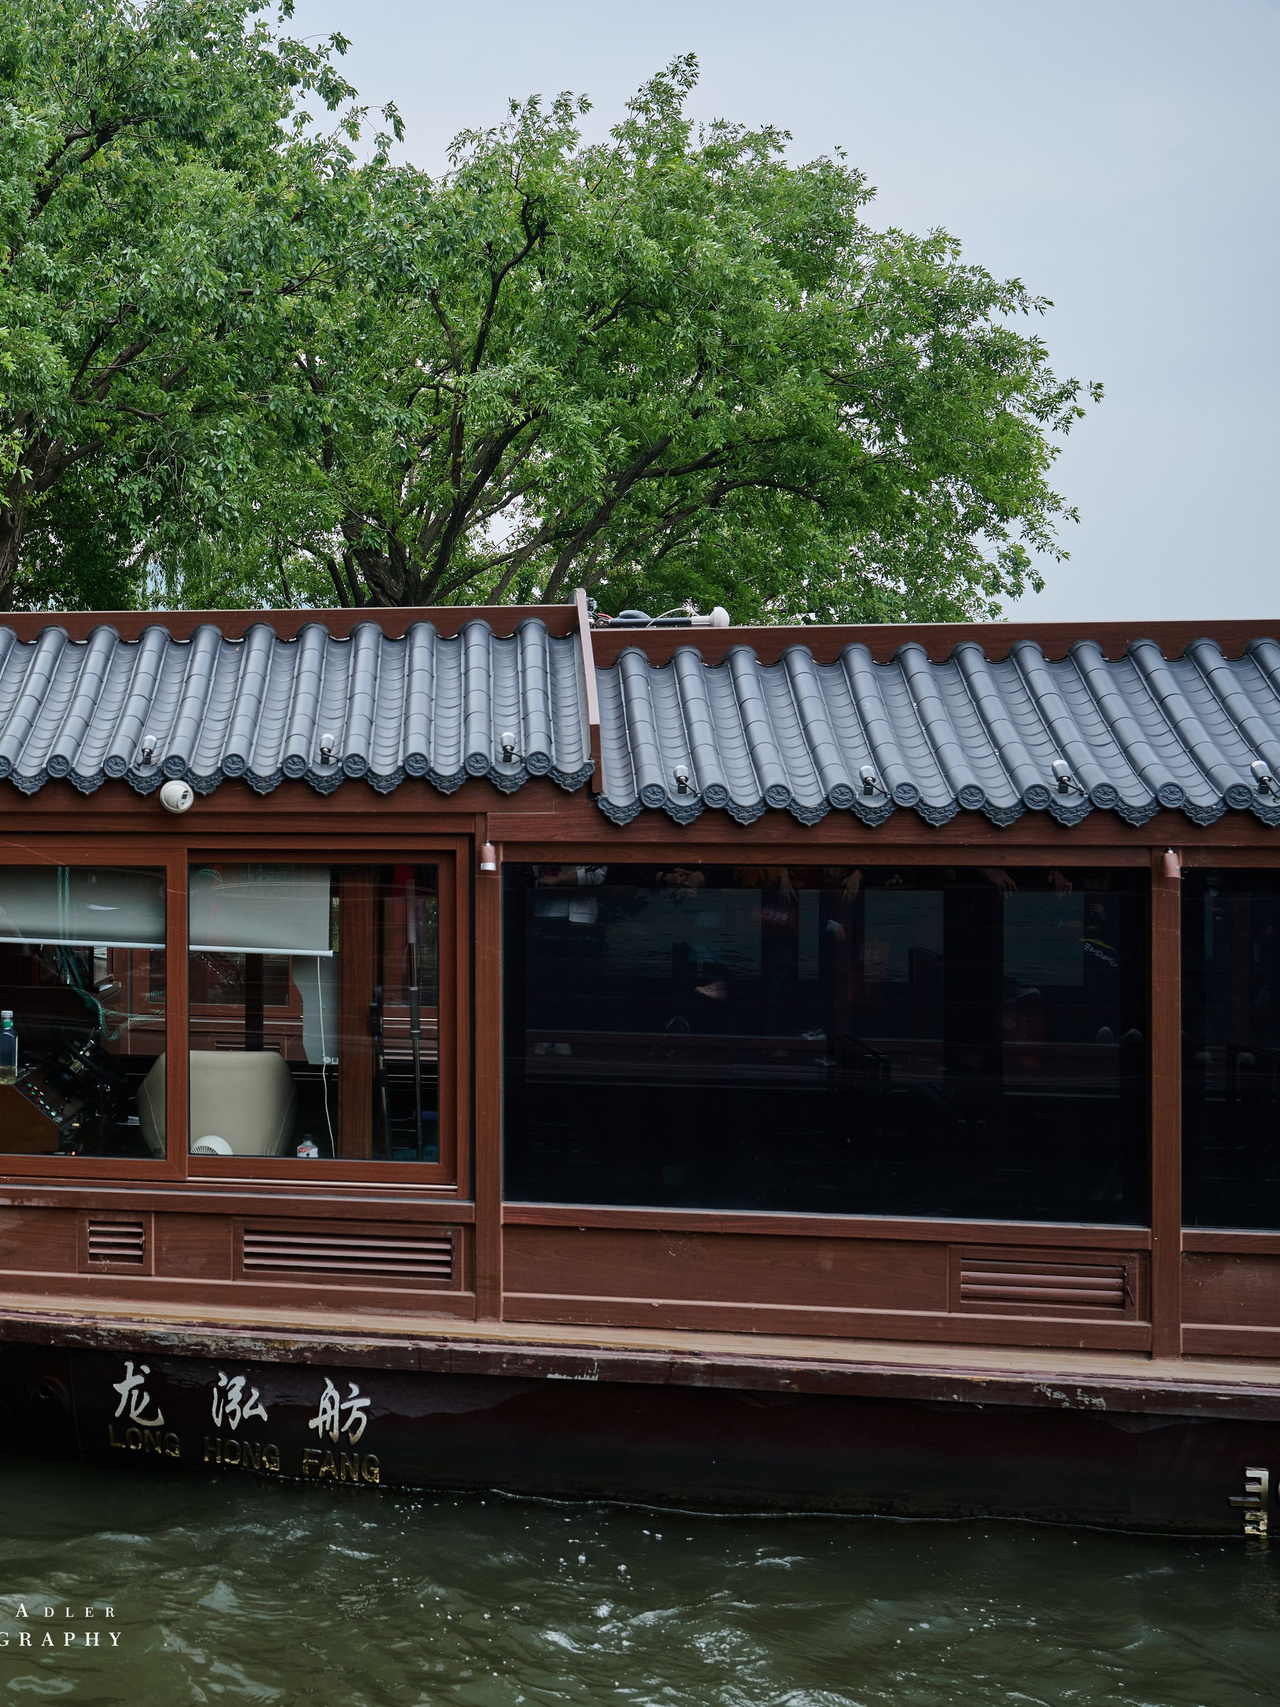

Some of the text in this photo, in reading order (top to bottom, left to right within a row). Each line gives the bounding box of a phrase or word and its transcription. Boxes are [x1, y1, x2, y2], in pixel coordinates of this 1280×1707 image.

[112, 1360, 371, 1446] 龙泓舫
[108, 1424, 380, 1484] LONG HONG FANG
